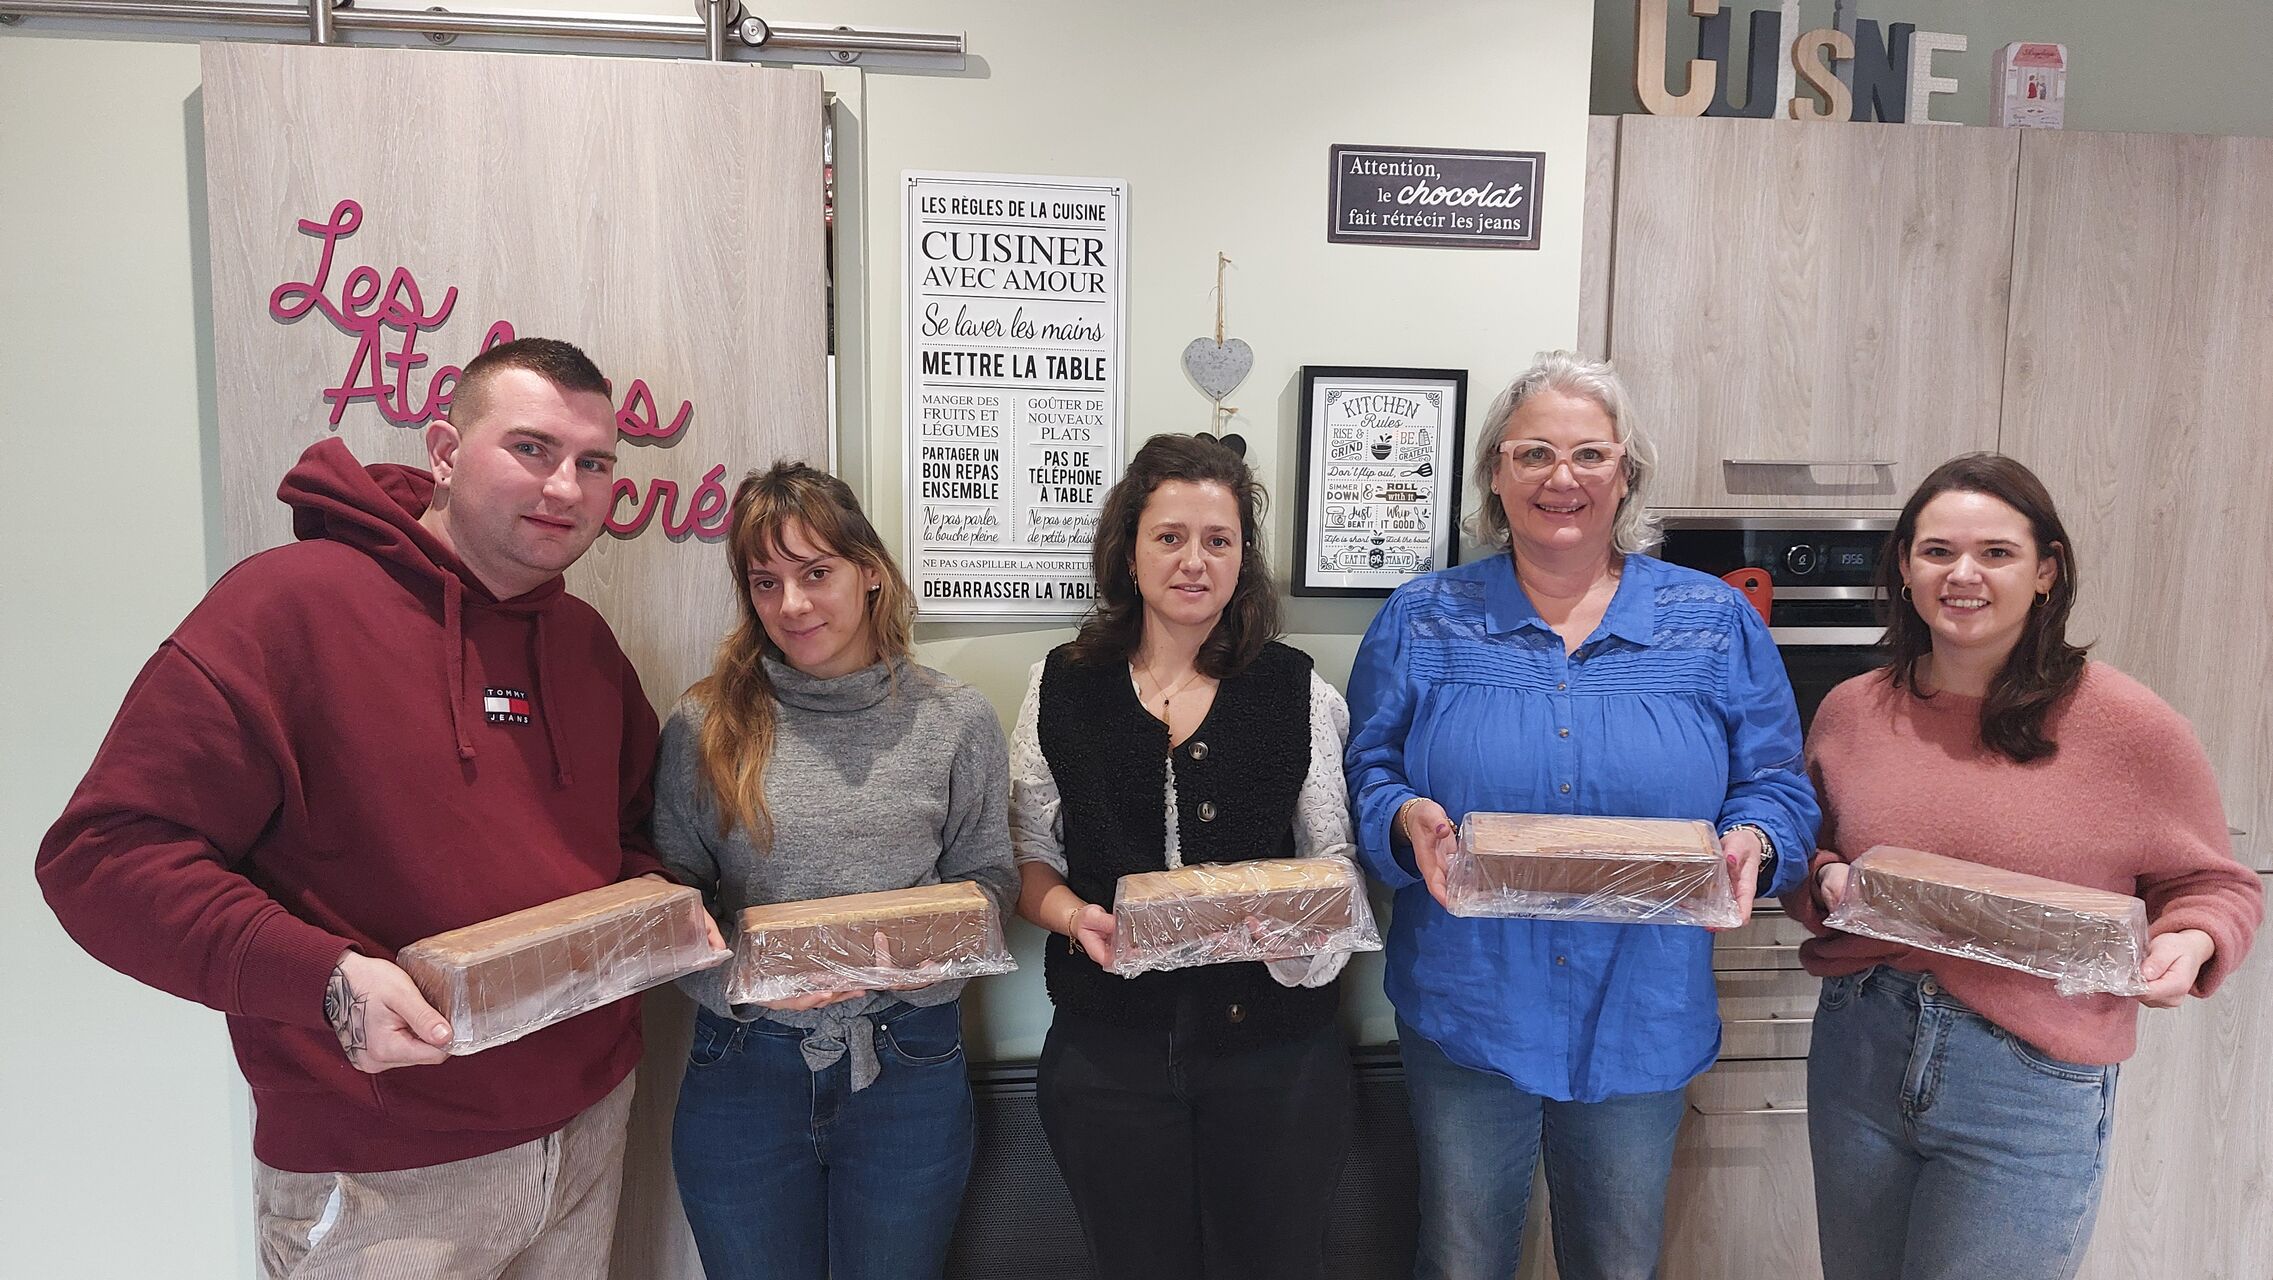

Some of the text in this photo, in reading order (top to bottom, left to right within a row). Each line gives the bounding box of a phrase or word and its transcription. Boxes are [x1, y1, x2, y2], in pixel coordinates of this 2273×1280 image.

[1350, 156, 1441, 180] Attention,
[1377, 179, 1523, 208] le chocolat
[922, 195, 1106, 221] LES RÈGLES DE LA CUISINE
[1348, 209, 1521, 233] fait rétrécir les jeans
[922, 231, 1107, 267] CUISINER
[269, 199, 458, 332] Les
[923, 266, 1106, 293] AVEC AMOUR
[922, 302, 1105, 342] Se laver les mains
[922, 351, 1106, 381] METTRE LA TABLE
[922, 394, 999, 406] MANGER DES
[1028, 396, 1104, 411] GOÛTER DE
[1342, 395, 1420, 419] KITCHEN
[923, 408, 999, 421] FRUITS ET
[1028, 413, 1103, 425] NOUVEAUX
[1361, 413, 1403, 428] Rules
[922, 421, 999, 438] LÉGUMES
[1041, 427, 1090, 441] PLATS
[1333, 428, 1364, 439] RISE &
[922, 446, 999, 462] PARTAGER UN
[1331, 441, 1363, 458] GRIND
[1399, 446, 1434, 460] GRATEFUL
[1044, 451, 1089, 467] PAS DE
[923, 462, 999, 480] BON REPAS
[1028, 466, 1102, 485] TÉLÉPHONE
[1357, 466, 1376, 480] flip
[923, 481, 999, 499] ENSEMBLE
[1040, 484, 1093, 503] À TABLE
[1363, 484, 1374, 500] &
[1386, 483, 1418, 491] ROLL
[1327, 491, 1359, 500] DOWN
[1388, 493, 1415, 501] with it
[923, 506, 999, 530] Ne pas parler
[1028, 509, 1099, 529] Ne pas se prive
[1348, 506, 1372, 520] Just
[1386, 505, 1410, 521] Whip
[1347, 520, 1365, 528] BEAT
[1381, 520, 1414, 529] IT GOOD
[923, 525, 999, 546] la bouche pleine
[1027, 527, 1039, 542] de
[1040, 530, 1066, 547] petits
[1324, 534, 1340, 544] Life
[1349, 535, 1370, 543] short
[923, 559, 1094, 570] NE PAS GASPILLER LA NOURRITUR
[1344, 554, 1411, 564] EAT IT OR STARVE
[924, 577, 1101, 599] DÉBARRASSER LA TABLE
[487, 689, 525, 699] TOMMY
[490, 714, 529, 724] JEANS
